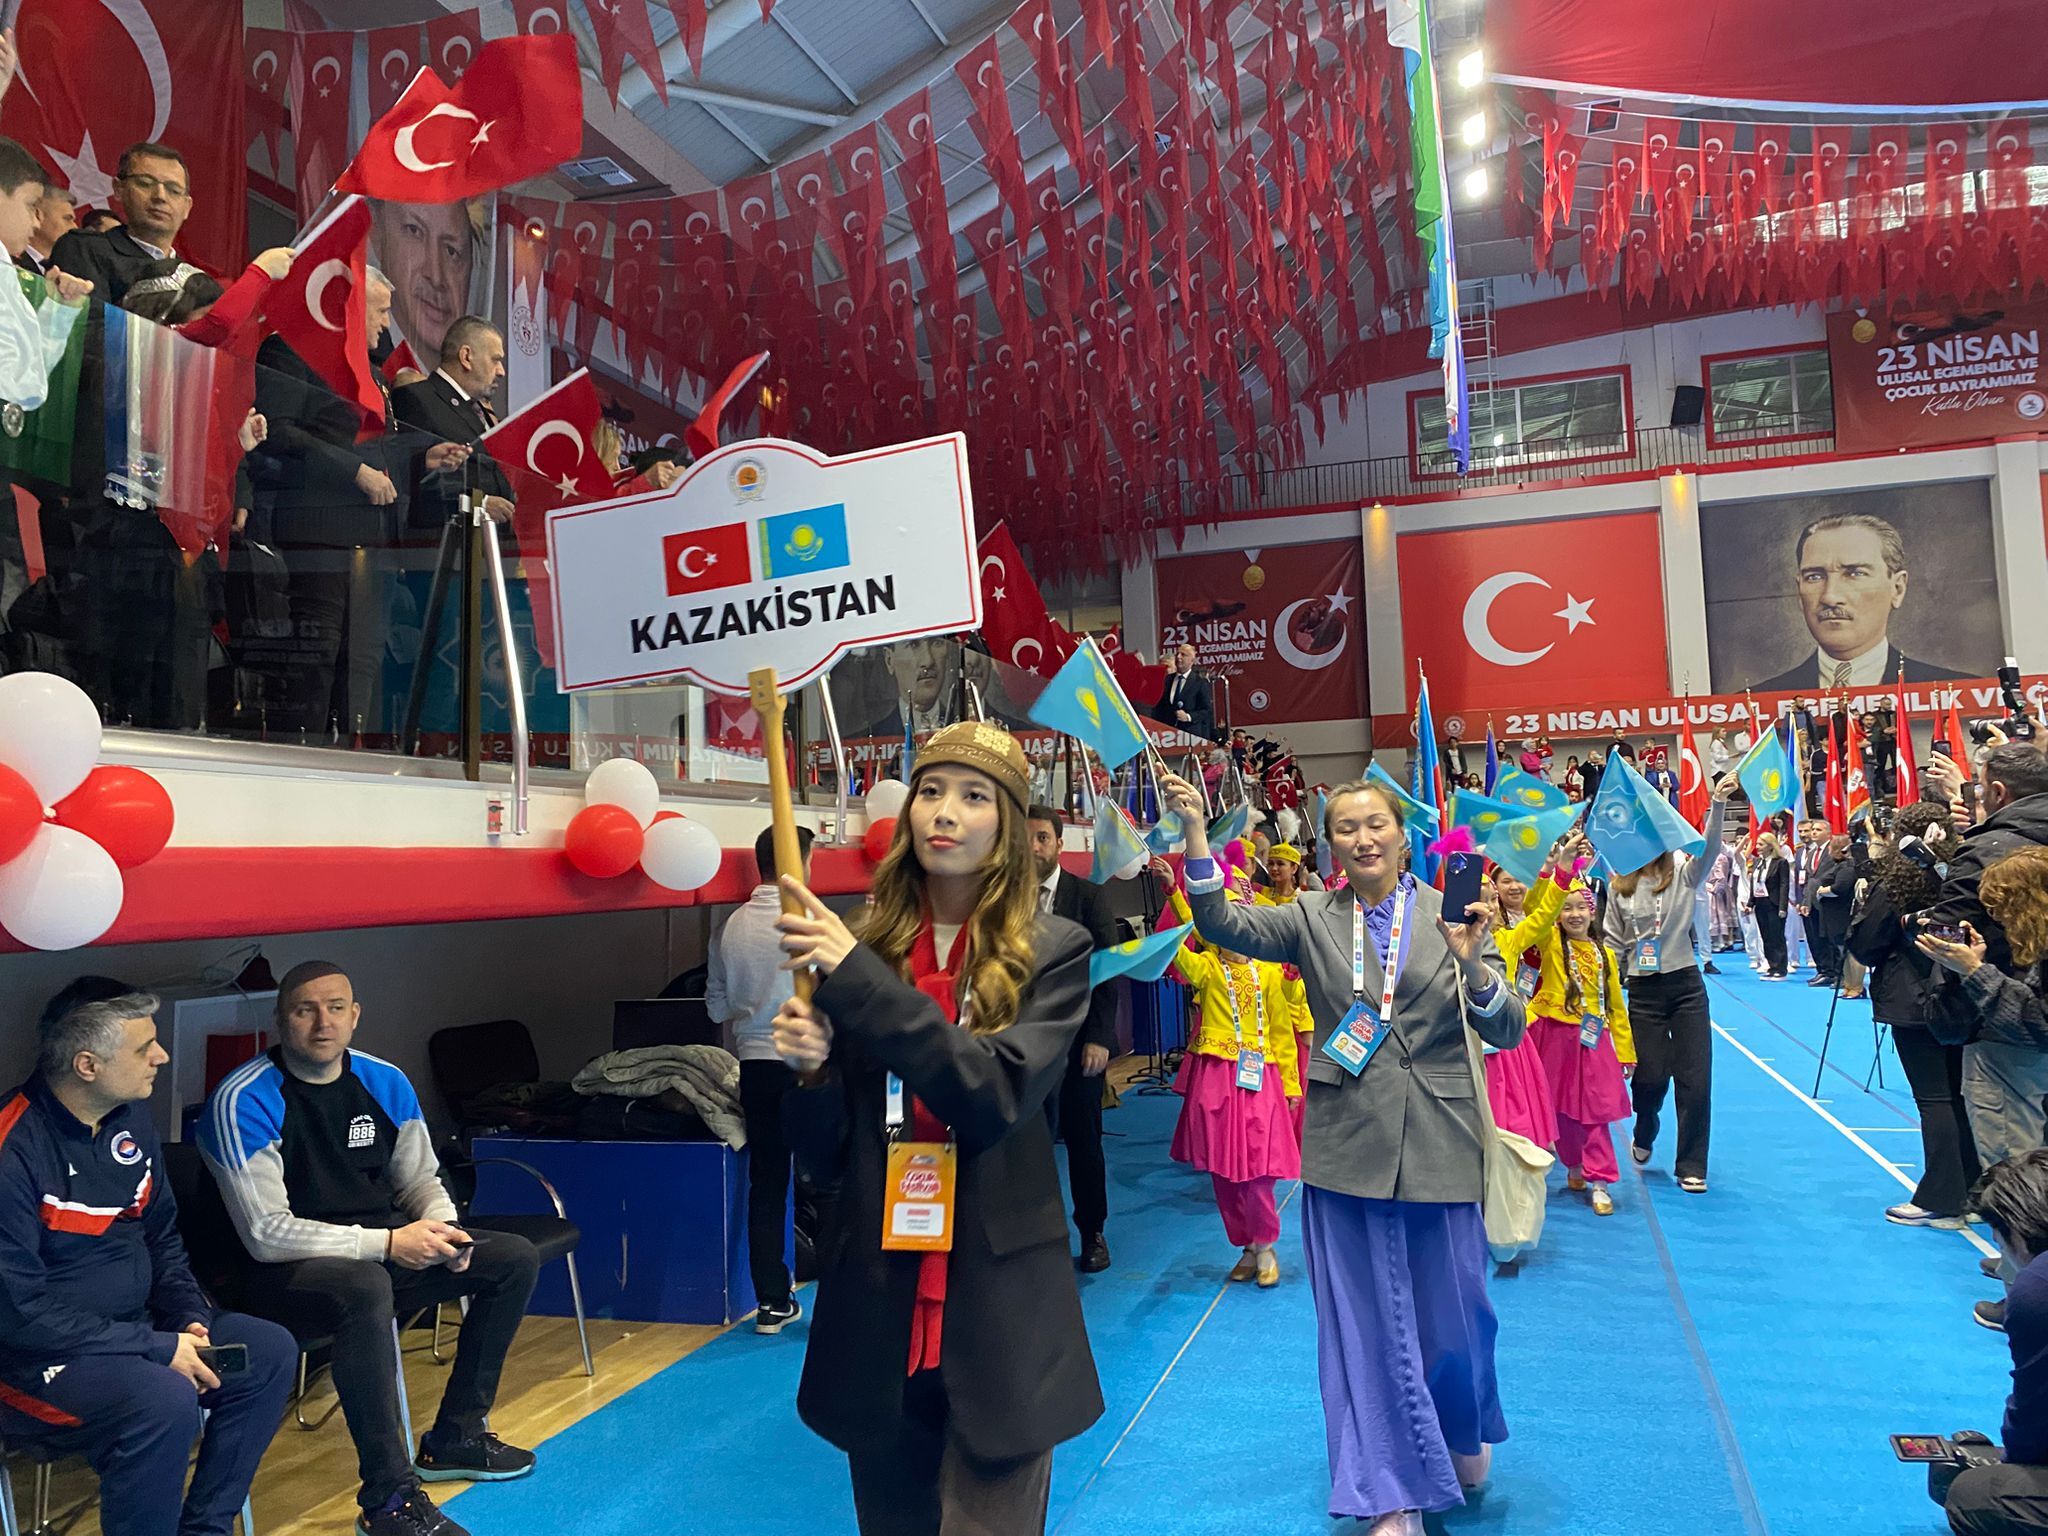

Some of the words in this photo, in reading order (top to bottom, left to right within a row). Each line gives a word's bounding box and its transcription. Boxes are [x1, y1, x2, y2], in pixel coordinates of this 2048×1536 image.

[1877, 344, 1918, 373] 23
[1927, 330, 2040, 367] NİSAN
[1876, 369, 1932, 386] ULUSAL
[1934, 359, 2016, 380] EGEMENLİK
[2018, 357, 2039, 369] VE
[1885, 383, 1938, 402] ÇOCUK
[1939, 372, 2037, 394] BAYRAMIMIZ
[630, 574, 897, 654] KAZAKİSTAN
[1163, 625, 1190, 646] 23
[1195, 619, 1267, 643] NİSAN
[1199, 640, 1252, 654] EGEMENLİK
[1252, 640, 1266, 649] VE
[1202, 651, 1264, 665] BAYRAMIMIZ
[1505, 714, 1541, 734] 23
[1648, 701, 1770, 727] ULUSAL
[348, 1125, 376, 1140] 1886
